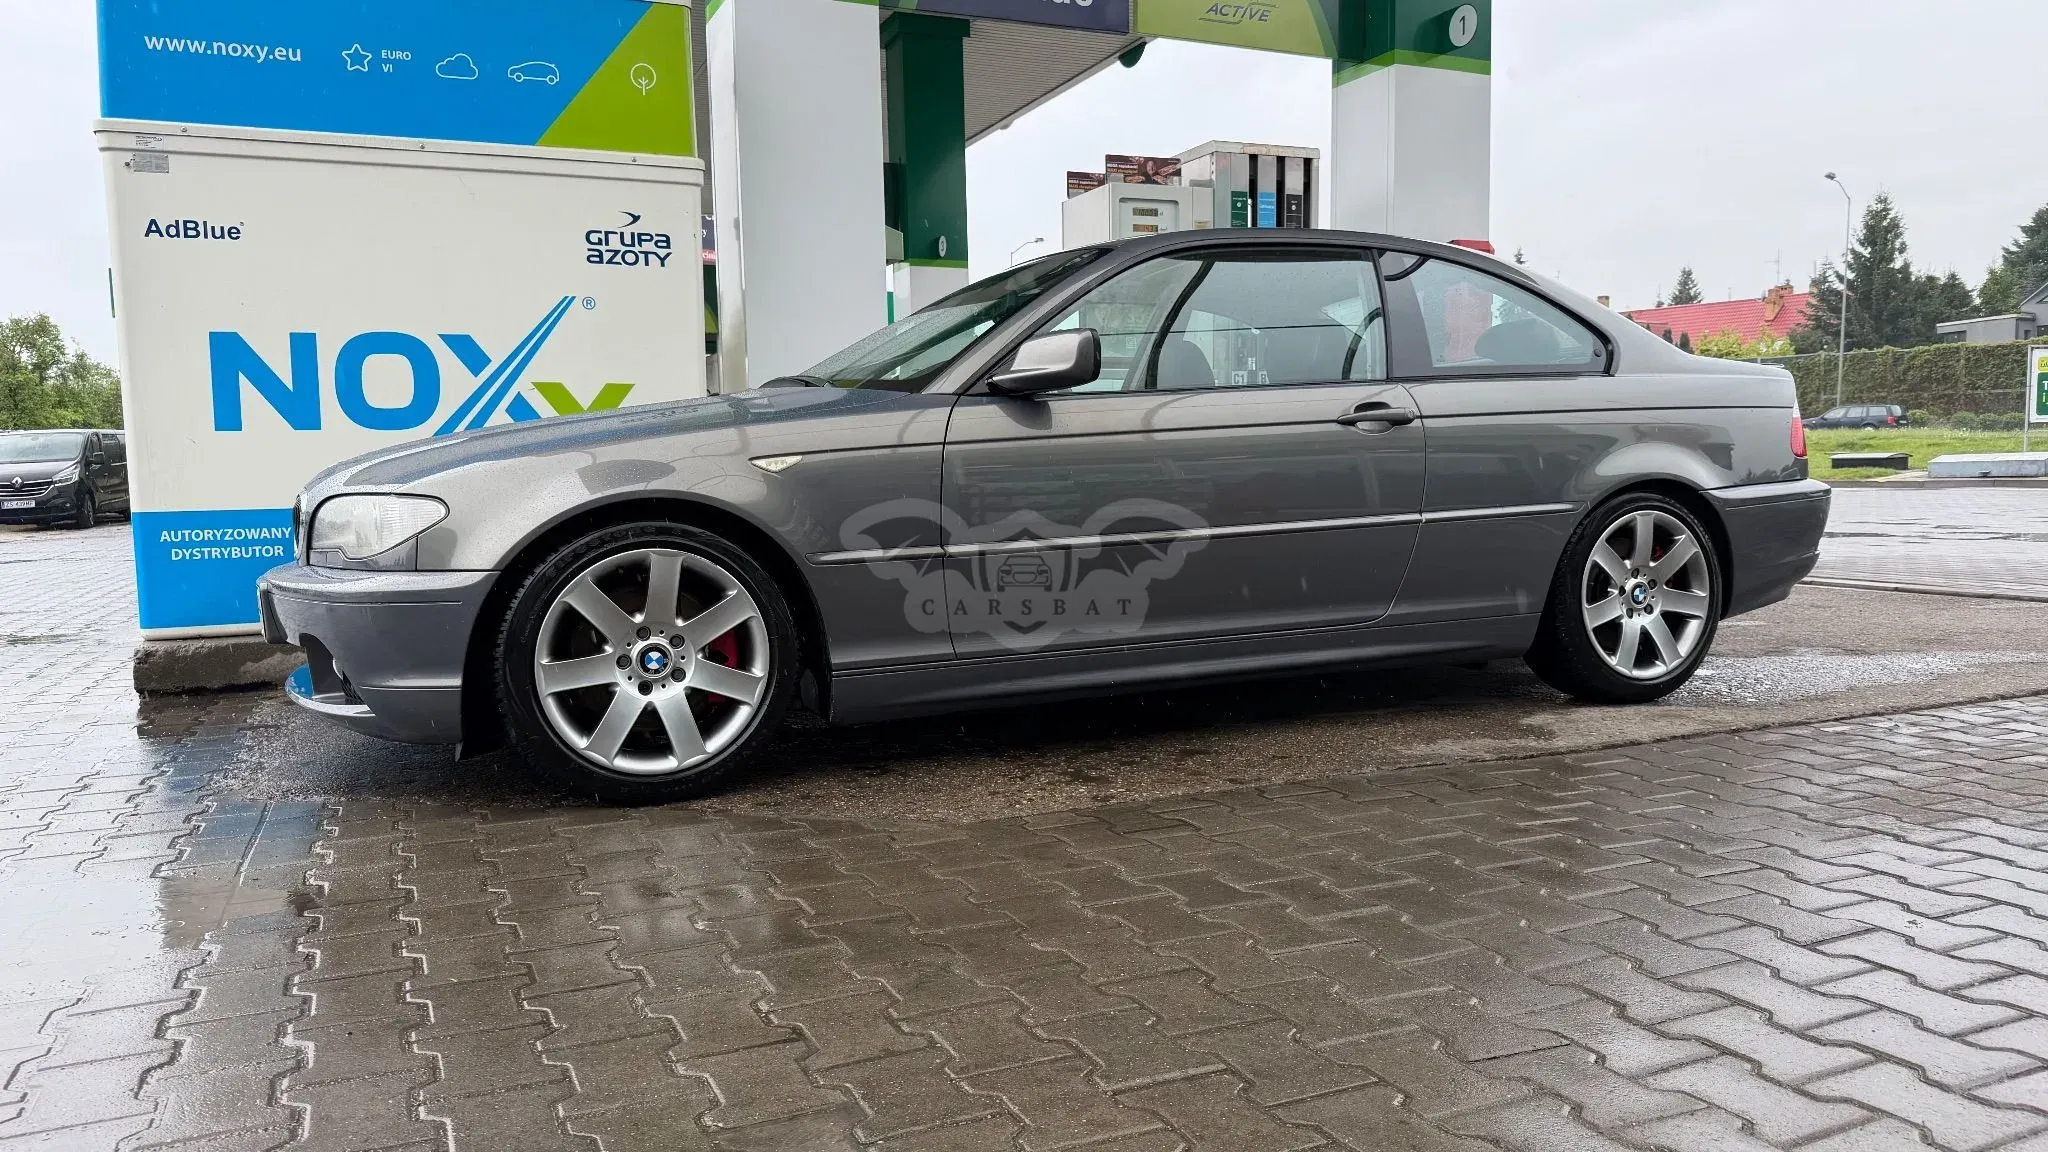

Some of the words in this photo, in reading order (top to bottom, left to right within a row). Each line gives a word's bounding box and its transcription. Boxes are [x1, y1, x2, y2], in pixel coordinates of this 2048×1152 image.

[1206, 3, 1272, 22] ACTIVE
[1459, 15, 1466, 36] 1
[144, 35, 301, 63] www.noxy.eu
[381, 49, 412, 61] EURO
[381, 63, 393, 73] VI
[160, 527, 291, 542] AUTORYZOWANY
[171, 545, 284, 561] DYSTRYBUTOR
